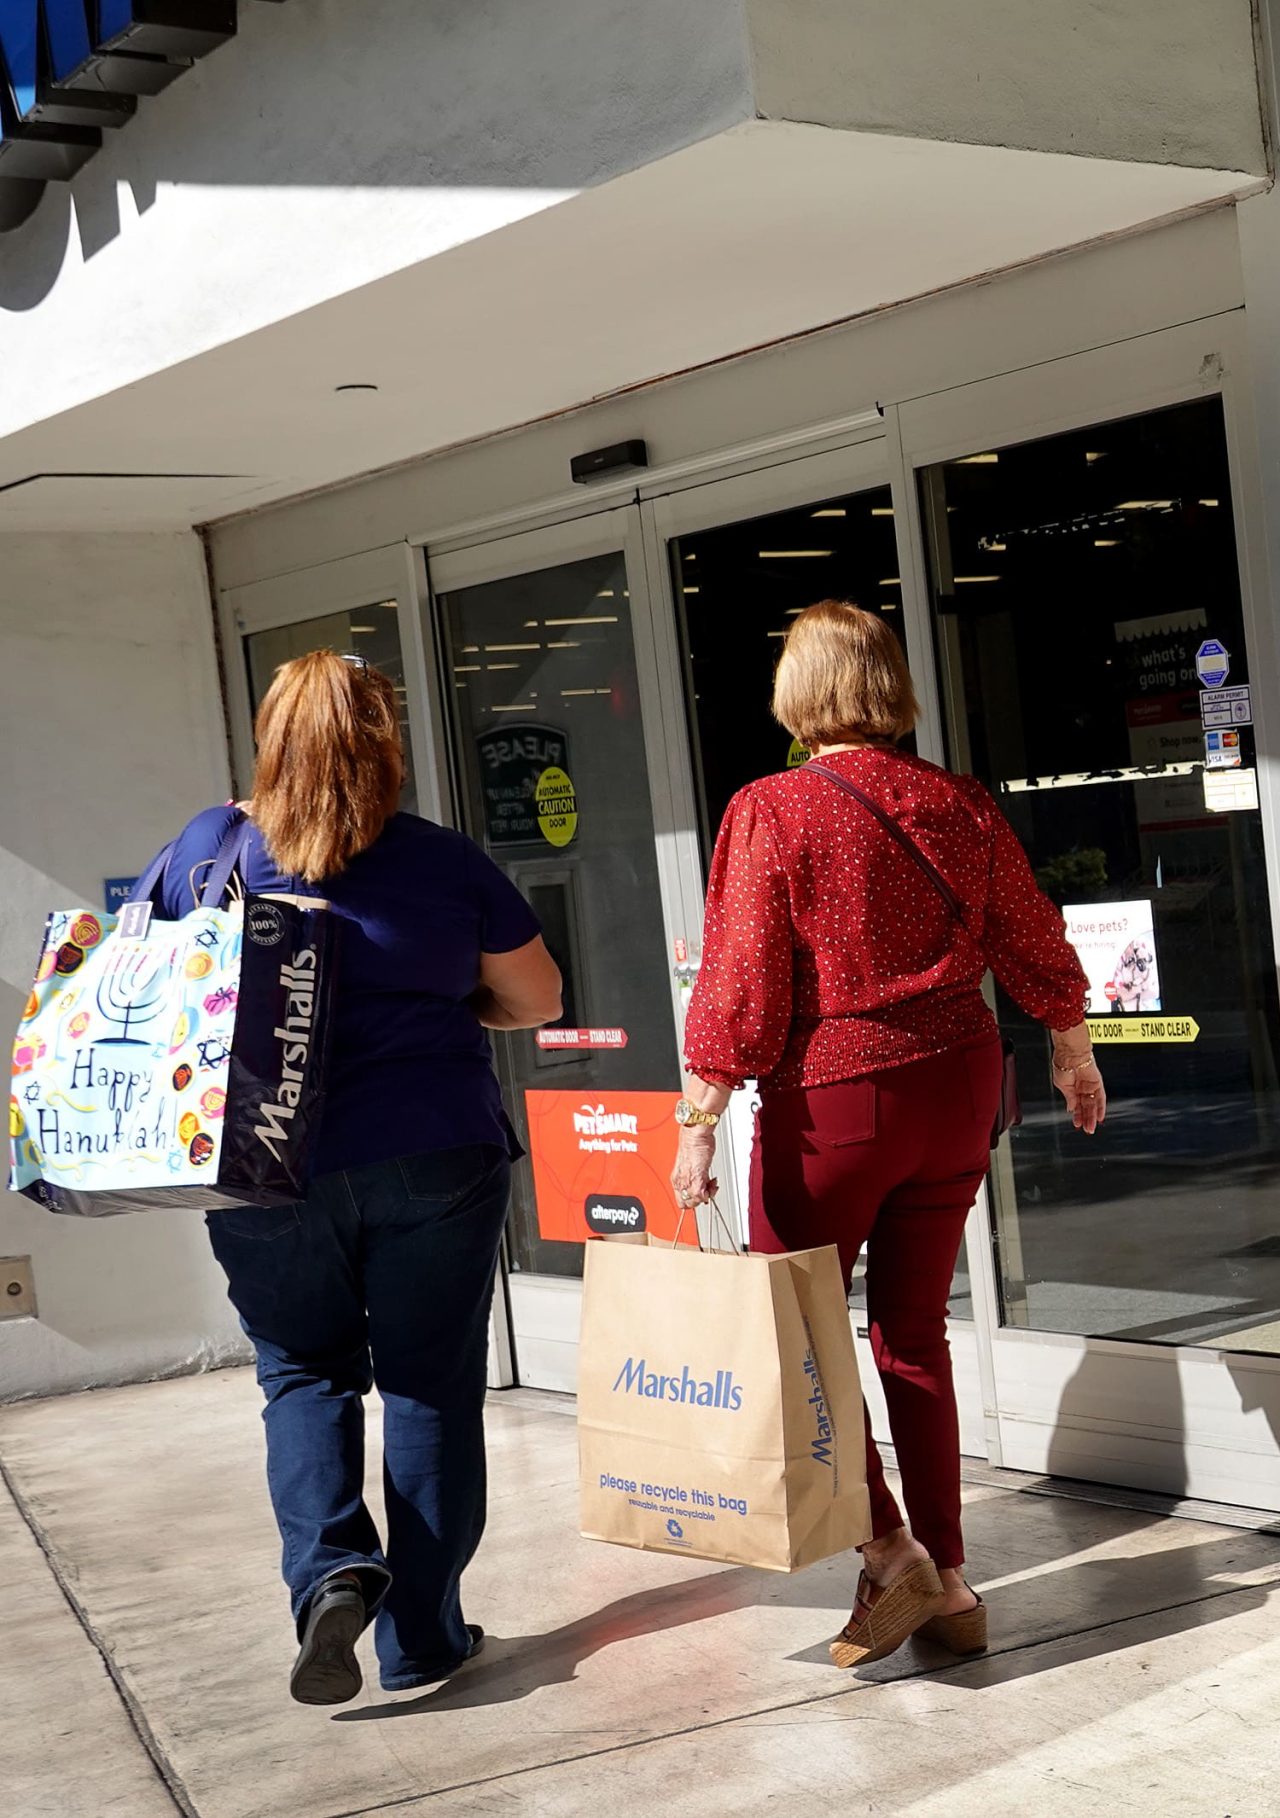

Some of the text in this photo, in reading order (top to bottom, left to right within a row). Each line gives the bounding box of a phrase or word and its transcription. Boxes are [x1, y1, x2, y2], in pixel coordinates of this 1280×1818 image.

[1141, 644, 1186, 667] what's
[1139, 668, 1176, 690] going
[1207, 691, 1243, 701] ALARM PERMIT
[1160, 736, 1181, 749] Shop
[538, 785, 571, 797] AUTOMATIC
[538, 798, 575, 815] CAUTION
[549, 818, 567, 828] DOOR
[251, 919, 278, 930] 100%
[1070, 918, 1129, 934] Love pets?
[539, 1030, 622, 1044] AUTOMATIC DOOR STAND CLEAR
[1103, 1023, 1123, 1038] DOOR
[1140, 1022, 1166, 1037] STAND
[1167, 1021, 1192, 1037] CLEAR
[254, 948, 317, 1163] Marshalls
[70, 1048, 152, 1112] Happy
[573, 1112, 638, 1135] PETSMART
[579, 1138, 638, 1154] Anything for Pets
[591, 1205, 629, 1225] afterpay
[612, 1357, 743, 1411] Marshalls
[600, 1472, 748, 1516] please recycle this bag
[659, 1505, 675, 1515] and
[675, 1507, 716, 1521] recyclable
